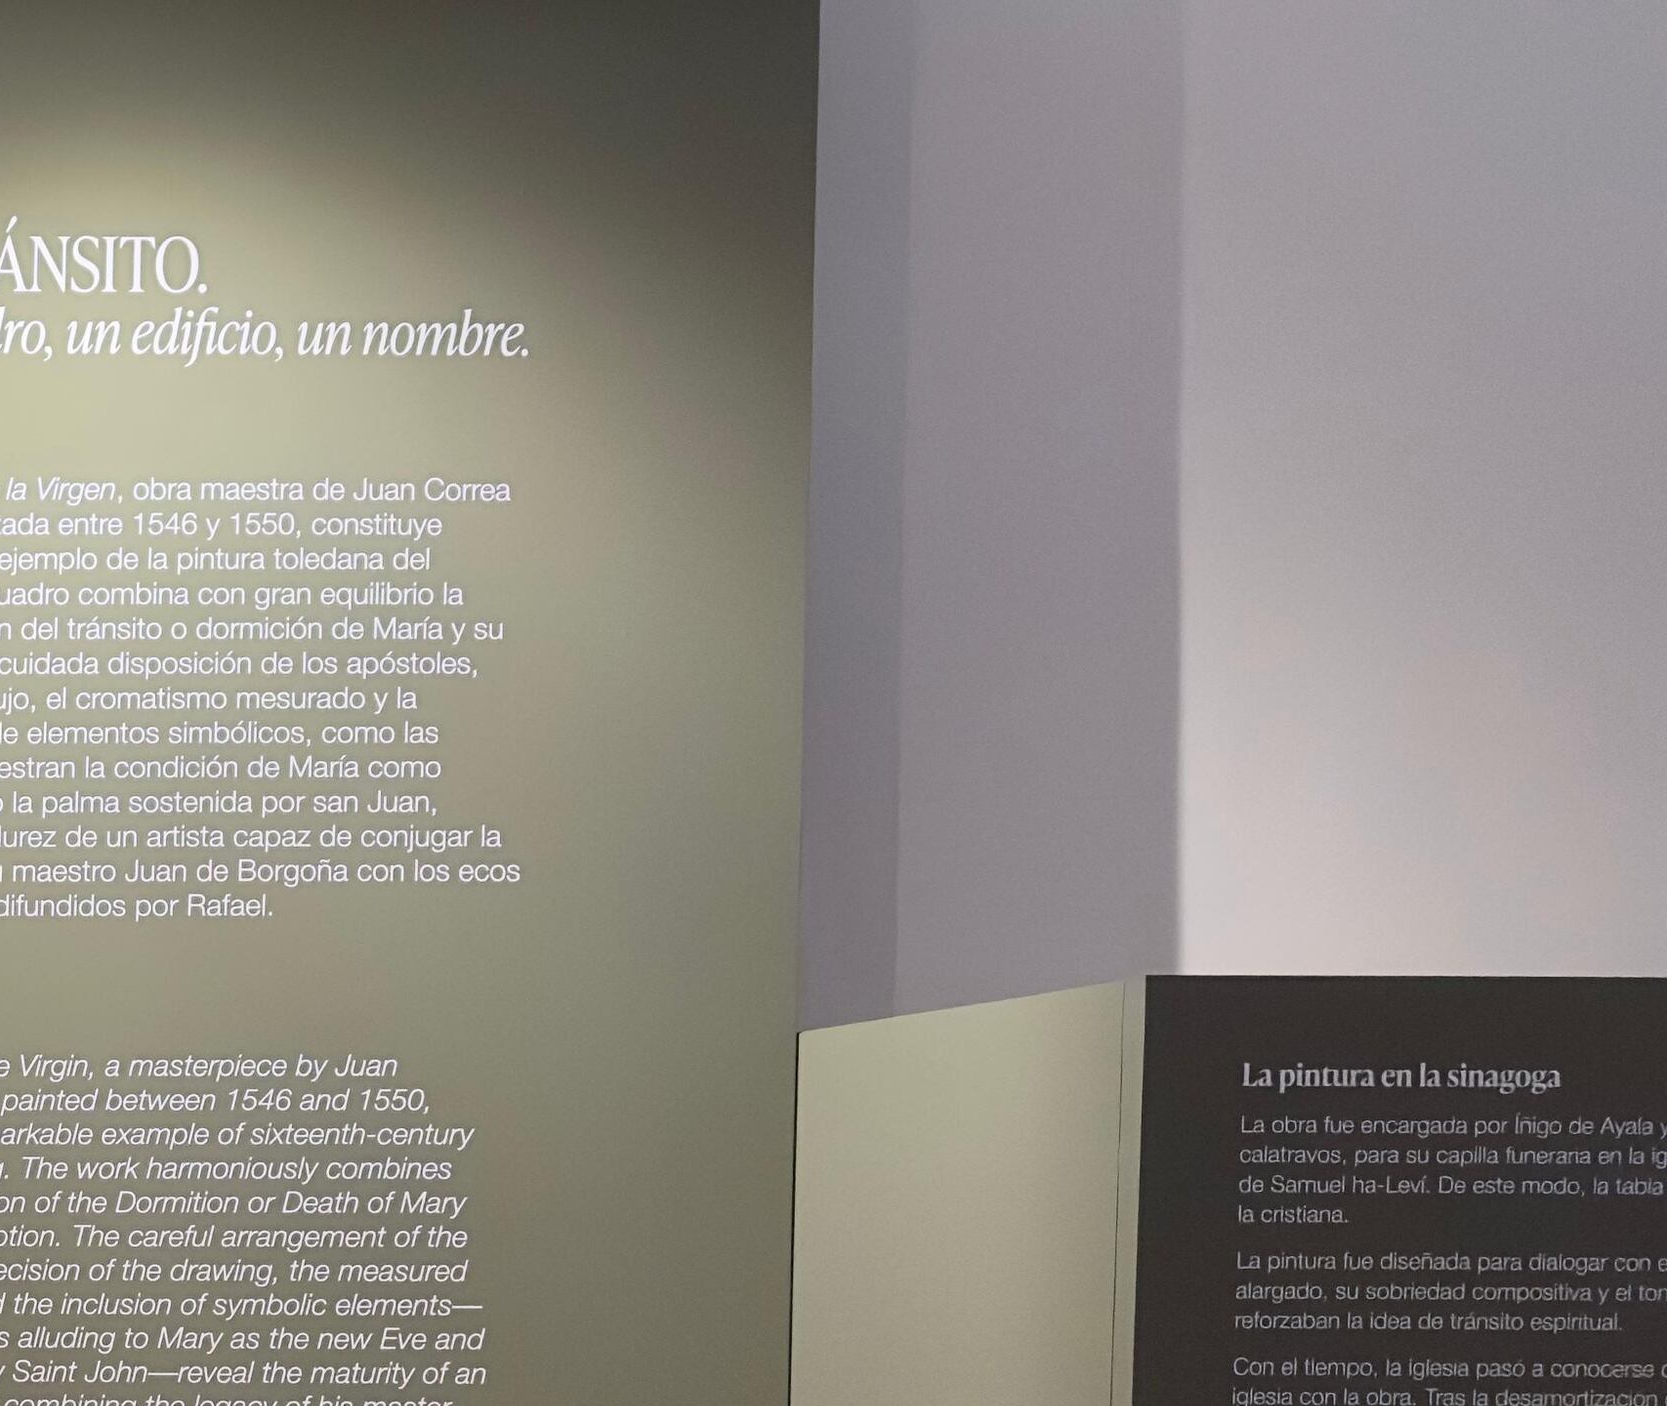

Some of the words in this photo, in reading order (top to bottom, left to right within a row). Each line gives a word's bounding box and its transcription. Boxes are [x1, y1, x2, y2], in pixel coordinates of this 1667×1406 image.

[66, 320, 122, 355] un
[130, 306, 284, 367] edificio,
[297, 321, 353, 356] un
[362, 308, 529, 358] nombre.
[5, 476, 28, 502] la
[37, 476, 123, 507] Virgen,
[132, 476, 193, 502] obra
[199, 477, 305, 502] maestra
[312, 477, 346, 504] de
[352, 477, 416, 506] Juan
[423, 476, 512, 504] Correa
[57, 512, 124, 537] entre
[133, 511, 199, 536] 1546
[205, 517, 222, 542] y
[229, 511, 302, 540] 1550,
[310, 511, 443, 545] constituye
[105, 546, 140, 571] de
[147, 546, 170, 571] la
[176, 546, 266, 576] pintura
[272, 546, 386, 572] toledana
[391, 546, 431, 573] del
[12, 859, 117, 884] maestro
[124, 858, 188, 883] Juan
[195, 858, 230, 883] de
[237, 858, 350, 888] Borgoña
[356, 863, 405, 883] con
[413, 858, 451, 883] los
[458, 863, 521, 883] ecos
[135, 898, 180, 923] por
[187, 892, 273, 917] Rafael.
[20, 1053, 94, 1083] Virgin,
[103, 1059, 121, 1078] a
[127, 1053, 288, 1083] masterpiece
[294, 1053, 329, 1083] by
[333, 1053, 398, 1078] Juan
[1242, 1062, 1273, 1087] La
[1278, 1062, 1376, 1094] pintura
[1380, 1069, 1413, 1088] en
[1419, 1062, 1442, 1088] la
[1446, 1062, 1561, 1095] sinagoga
[0, 1087, 100, 1118] painted
[104, 1087, 217, 1112] between
[228, 1087, 293, 1112] 1546
[298, 1087, 351, 1112] and
[360, 1088, 430, 1115] 1550,
[100, 1121, 210, 1152] example
[217, 1121, 247, 1146] of
[249, 1121, 476, 1152] sixteenth-century
[1237, 1204, 1256, 1224] la
[1260, 1204, 1349, 1224] cristiana.
[1234, 1310, 1341, 1330] reforzaban
[1346, 1310, 1364, 1330] la
[1368, 1310, 1412, 1331] idea
[1417, 1311, 1444, 1330] de
[1449, 1311, 1525, 1331] tránsito
[1529, 1312, 1623, 1335] espiritual.
